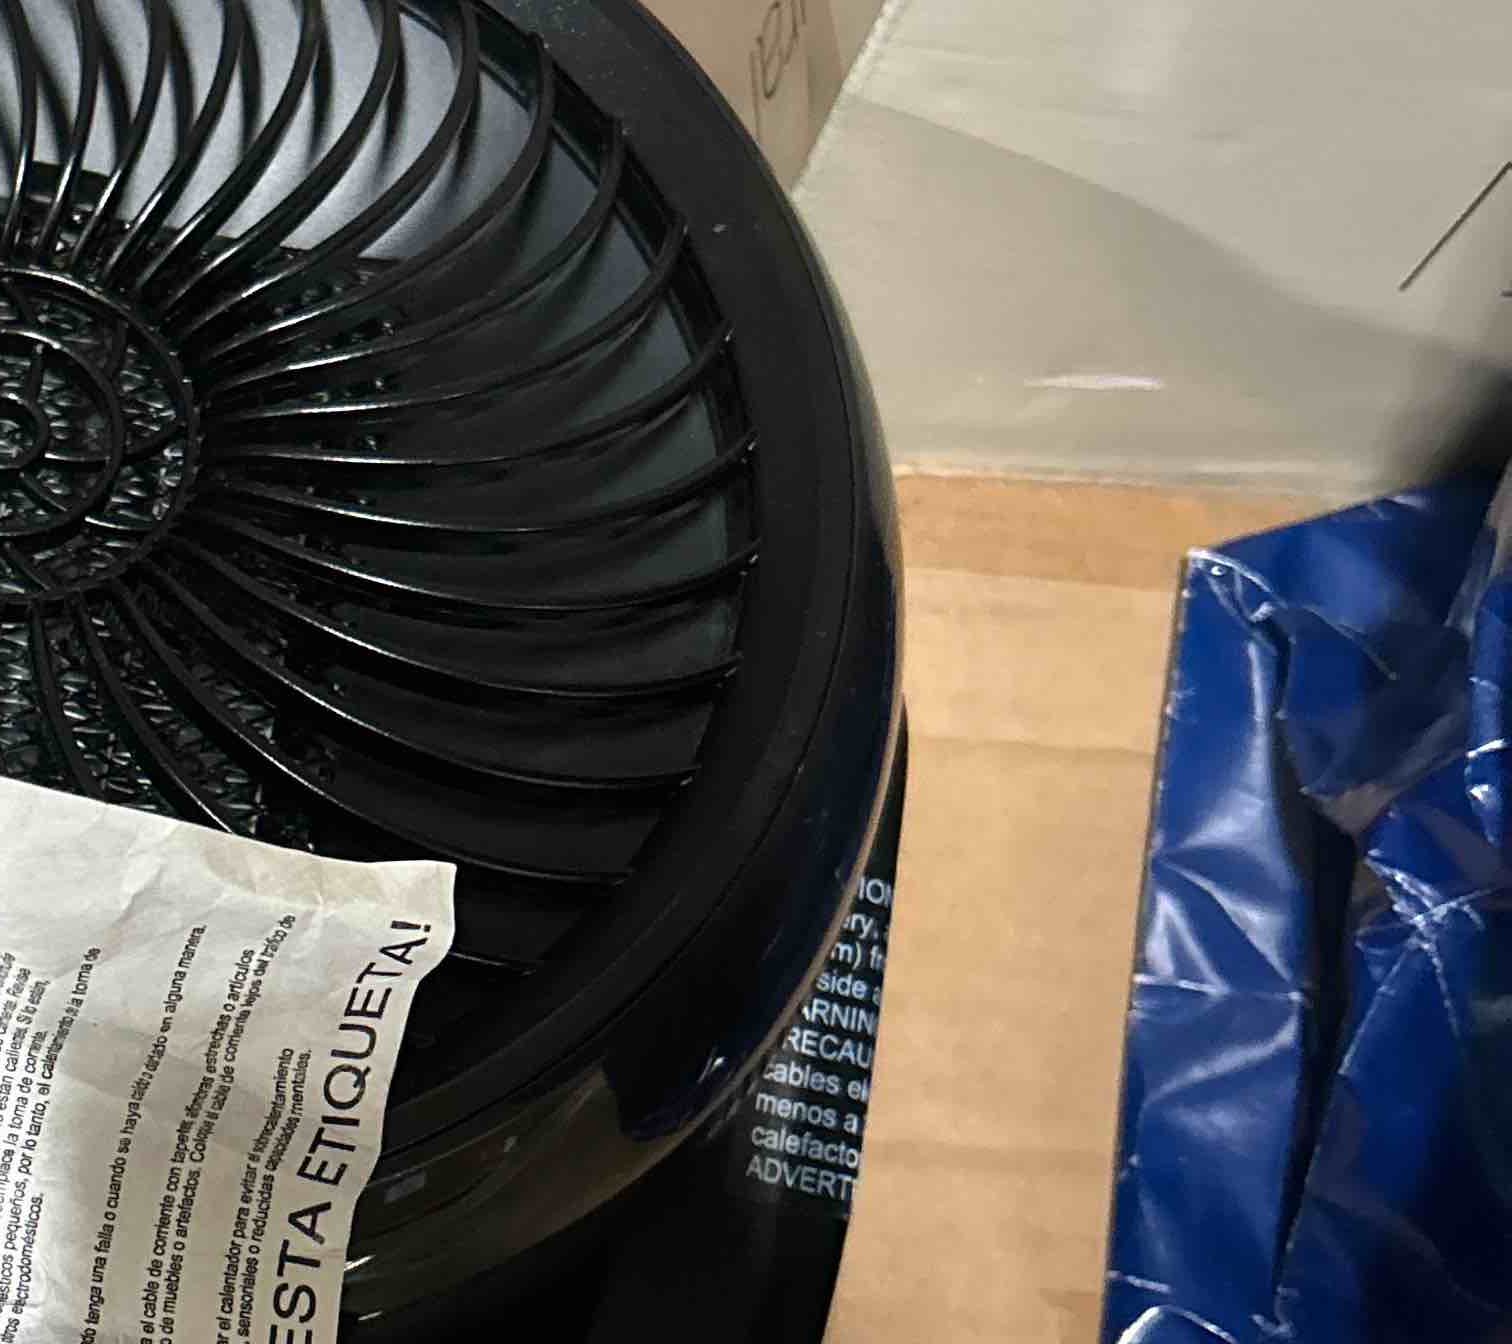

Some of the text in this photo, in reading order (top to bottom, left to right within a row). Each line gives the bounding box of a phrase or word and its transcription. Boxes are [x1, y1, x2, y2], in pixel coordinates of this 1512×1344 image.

[176, 921, 206, 969] manera.
[72, 962, 93, 996] toma
[161, 969, 187, 1013] alguna
[815, 969, 868, 1000] side
[222, 1002, 235, 1012] o
[158, 1015, 172, 1033] en
[296, 913, 432, 1188] ETIQUETA!
[16, 1075, 32, 1094] de
[35, 1081, 51, 1096] el
[219, 1064, 236, 1084] de
[288, 1047, 312, 1116] mentales.
[8, 1095, 28, 1130] toma
[26, 1097, 50, 1137] tanto,
[119, 1100, 144, 1136] haya
[754, 1090, 838, 1132] menos
[3, 1131, 19, 1146] la
[21, 1137, 37, 1151] lo
[17, 1152, 37, 1176] por
[164, 1165, 181, 1192] con
[103, 1155, 126, 1209] cuando
[237, 1164, 258, 1204] evitar
[2, 1176, 29, 1251] pequeños,
[102, 1210, 116, 1220] o
[172, 1167, 200, 1238] artefactos.
[248, 1173, 273, 1242] reducidas
[93, 1222, 115, 1254] falla
[150, 1193, 175, 1256] corriente
[231, 1205, 250, 1238] para
[173, 1240, 185, 1251] o
[247, 1244, 260, 1254] o
[90, 1254, 108, 1283] una
[146, 1257, 164, 1277] de
[162, 1252, 183, 1314] muebles
[216, 1239, 243, 1315] calentador
[79, 1284, 107, 1325] tenga
[140, 1279, 159, 1318] cable
[235, 1255, 259, 1337] sensoriales
[140, 1319, 155, 1334] el
[158, 1315, 176, 1334] de
[214, 1315, 231, 1330] el
